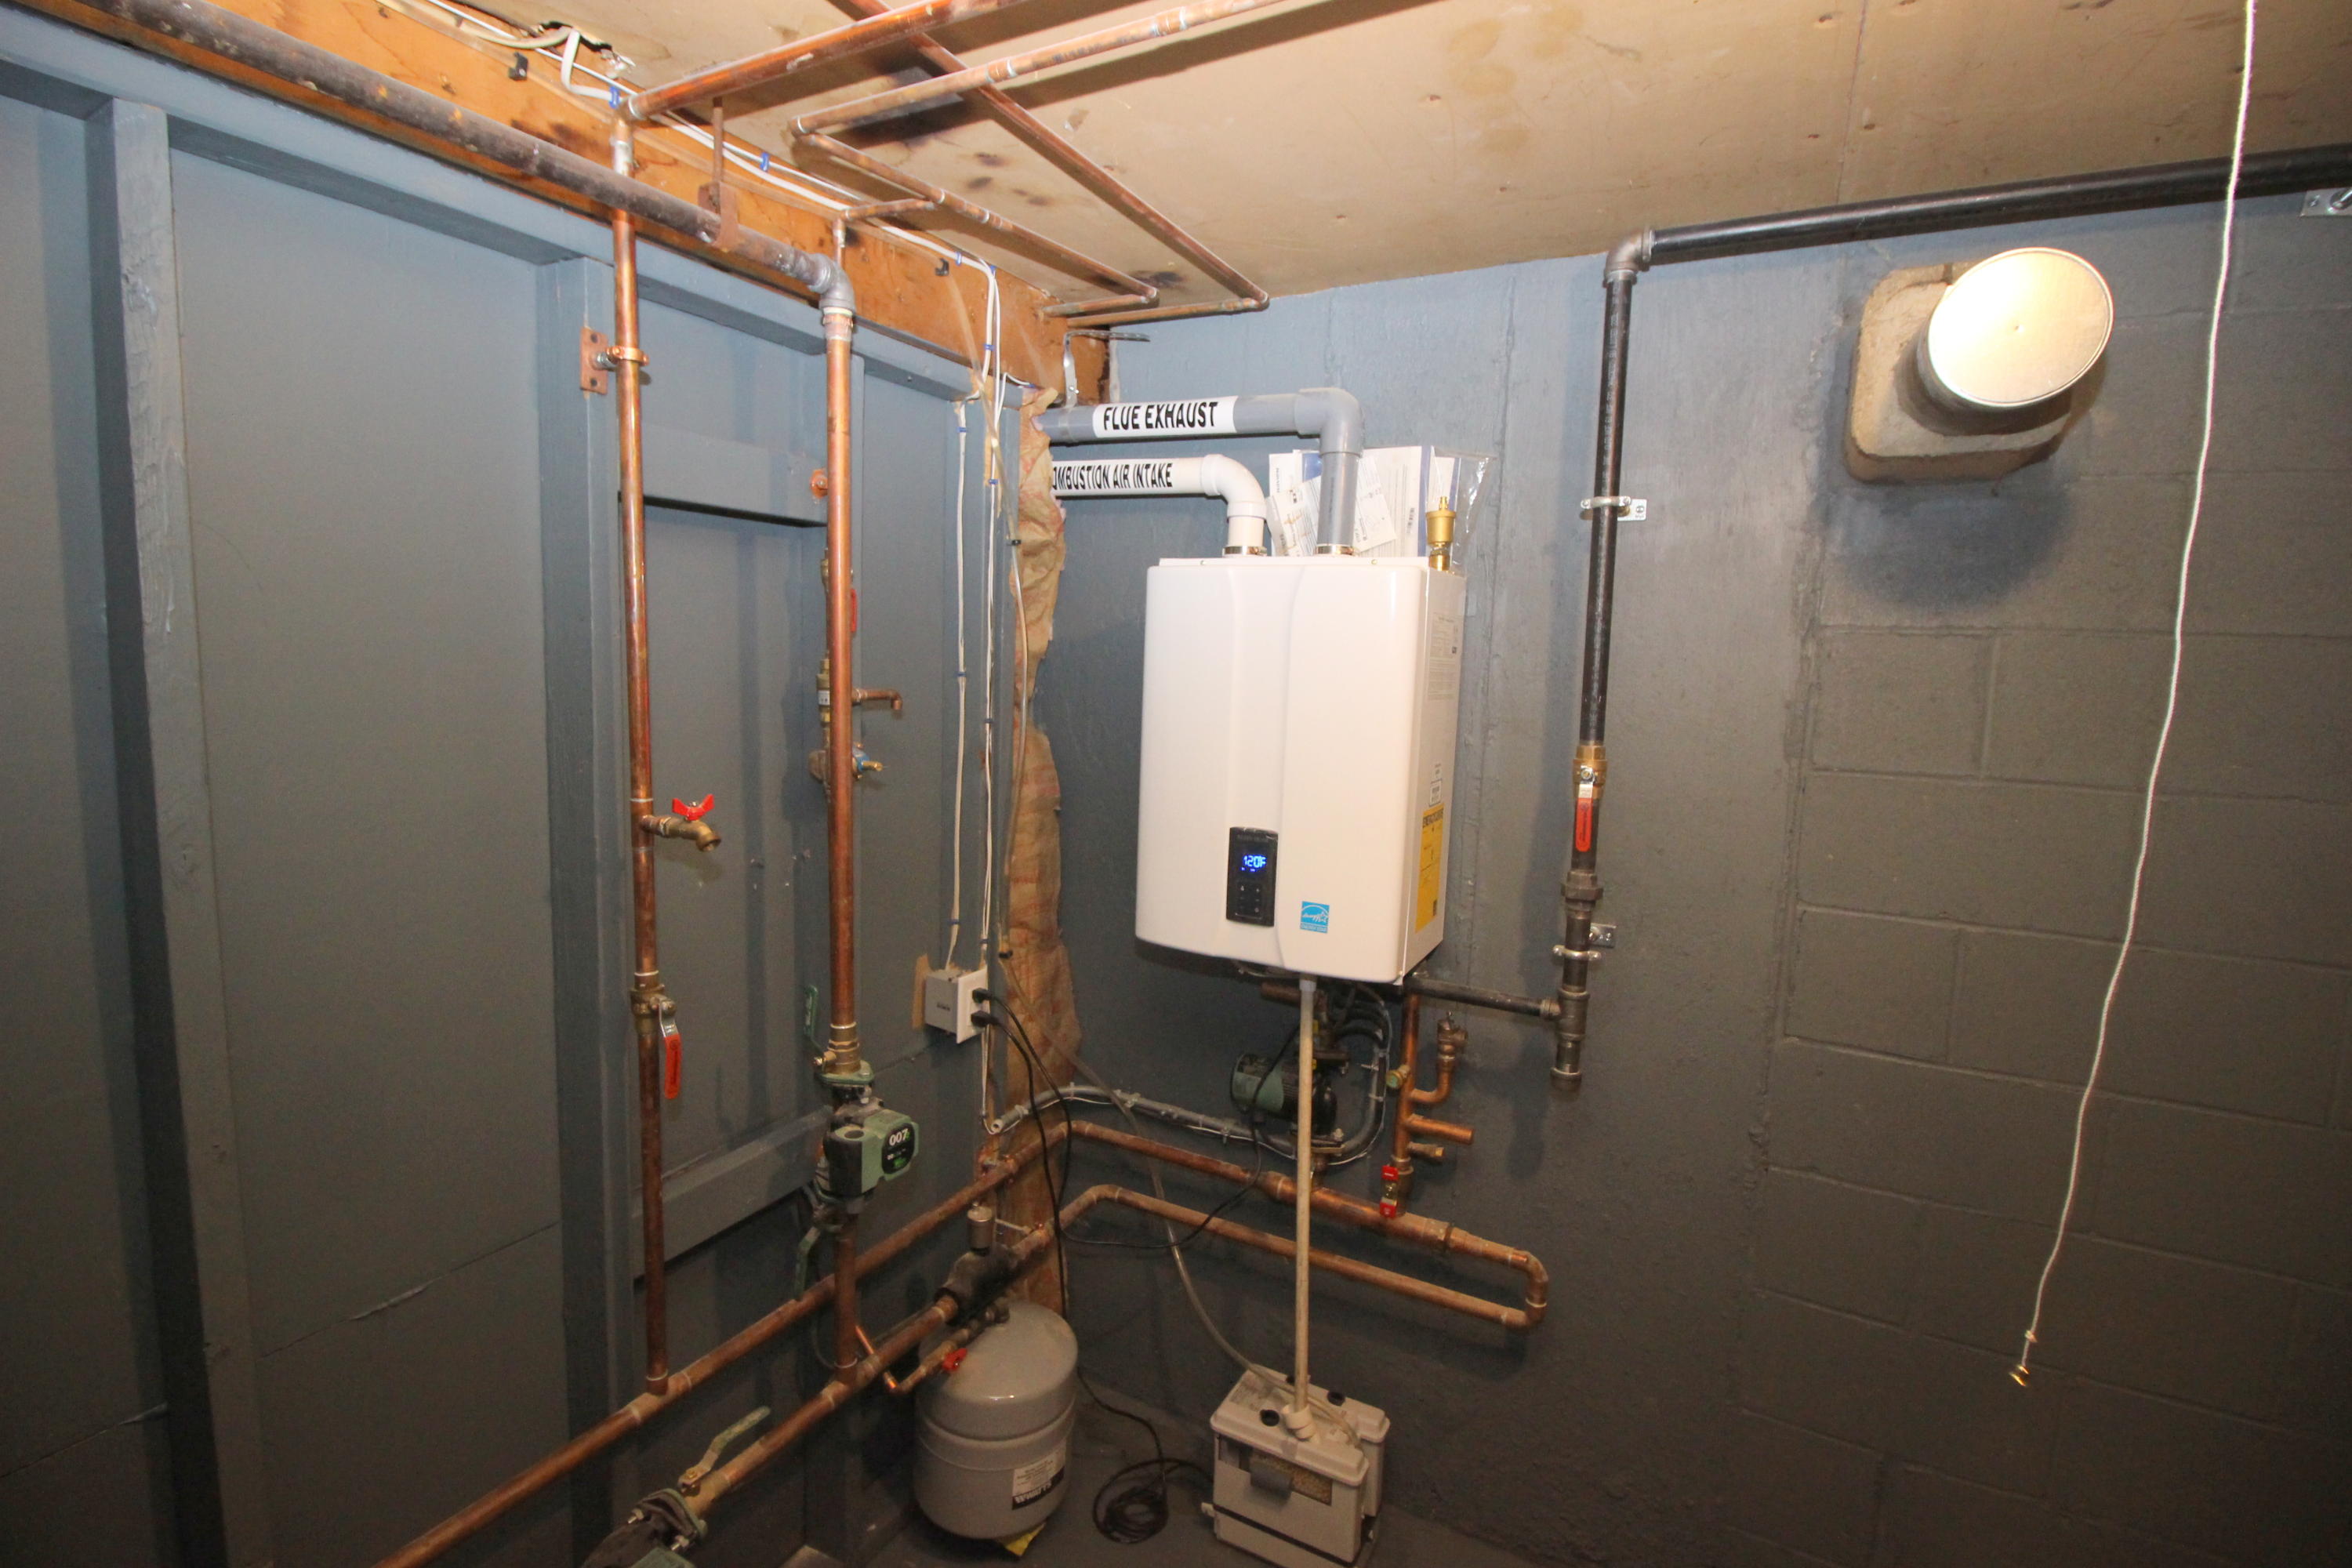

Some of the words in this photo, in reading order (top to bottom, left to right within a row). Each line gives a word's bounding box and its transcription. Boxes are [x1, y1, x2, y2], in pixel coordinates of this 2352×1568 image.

[1103, 405, 1141, 430] FLUE
[1145, 401, 1218, 429] EXHAUST
[1113, 463, 1131, 489] AIR
[1133, 463, 1174, 488] INTAKE
[889, 1128, 909, 1146] 007
